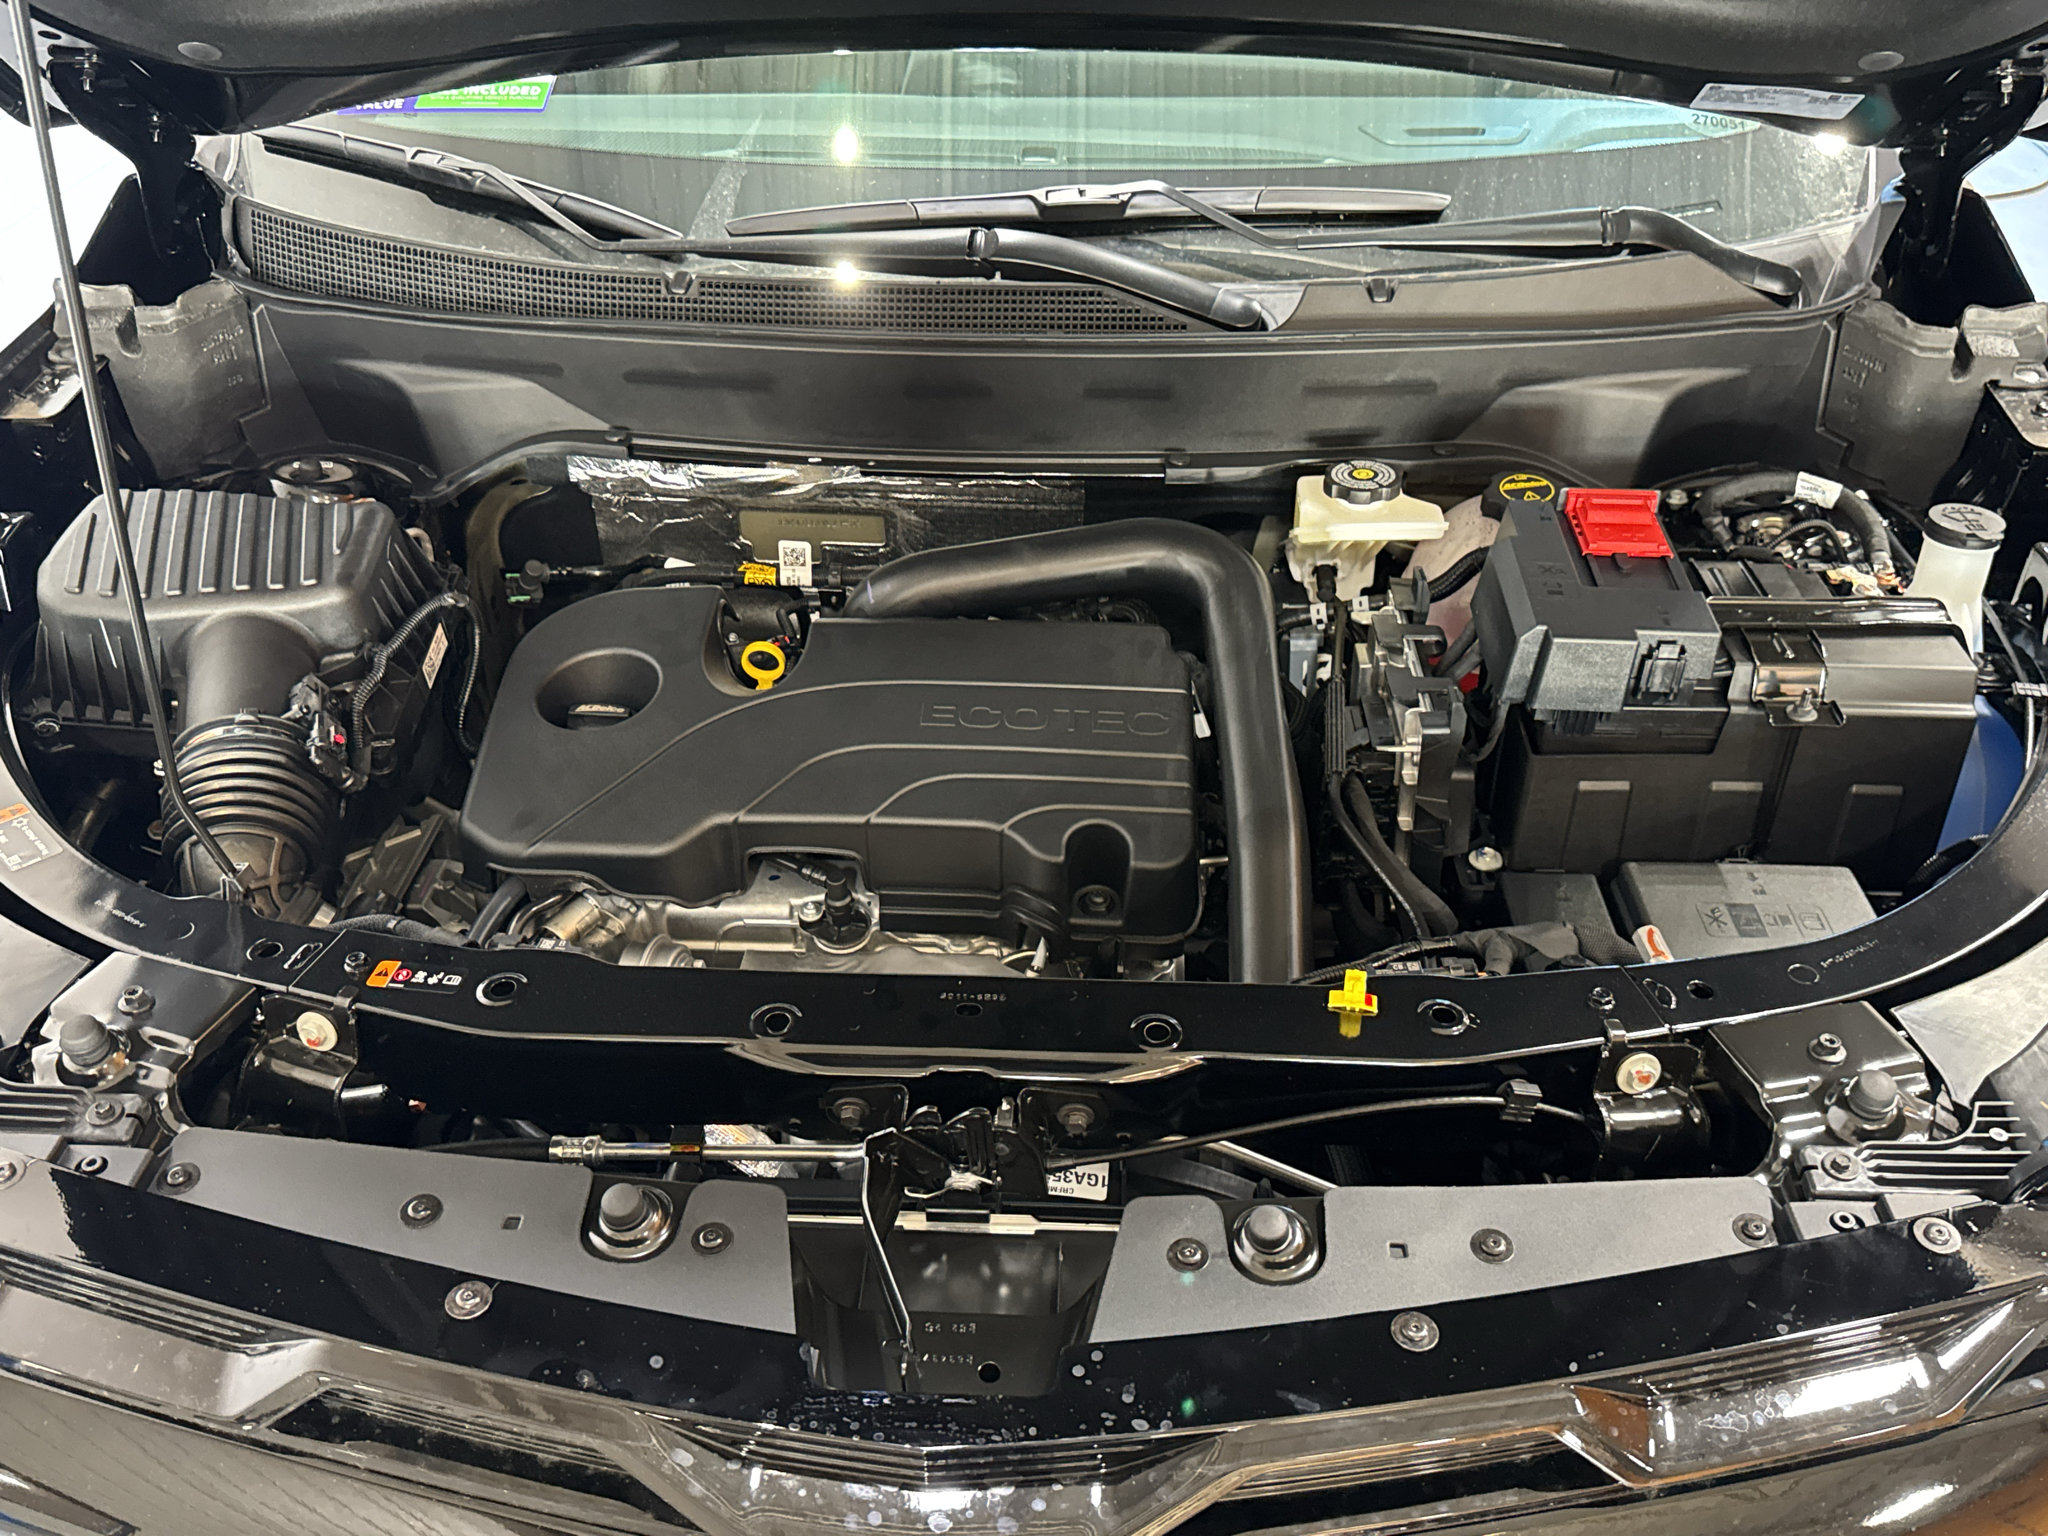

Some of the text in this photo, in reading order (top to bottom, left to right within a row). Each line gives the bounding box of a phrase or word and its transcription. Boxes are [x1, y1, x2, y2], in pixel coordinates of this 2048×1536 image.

[463, 85, 542, 96] INCLUDED
[1691, 113, 1746, 131] 270051
[920, 703, 1170, 736] ECOTEC
[1047, 1170, 1108, 1189] 1GA35
[1048, 1185, 1075, 1195] CRFM
